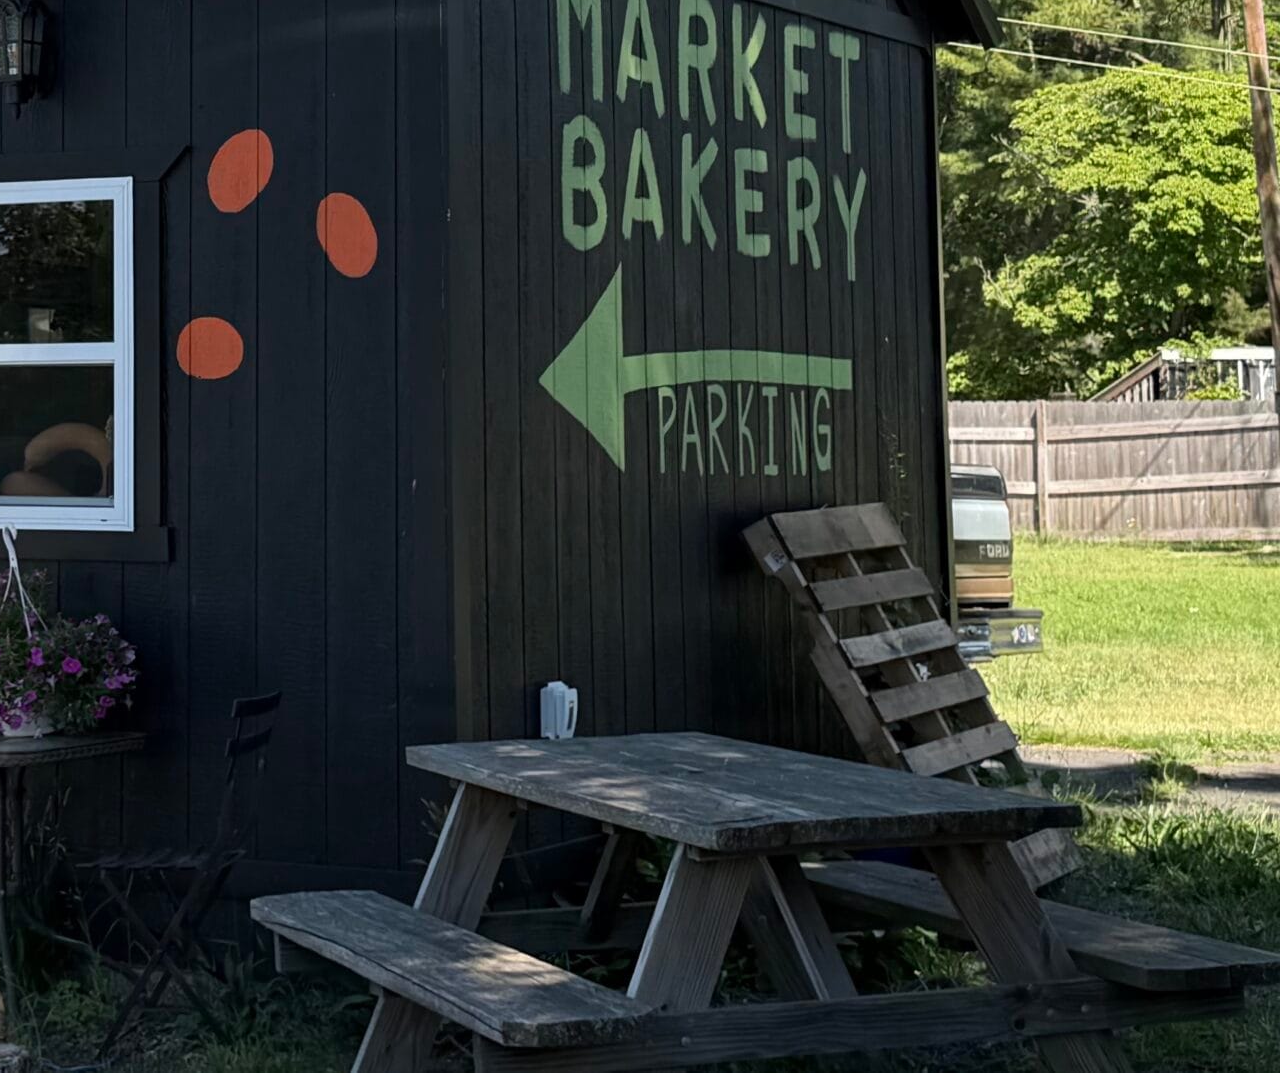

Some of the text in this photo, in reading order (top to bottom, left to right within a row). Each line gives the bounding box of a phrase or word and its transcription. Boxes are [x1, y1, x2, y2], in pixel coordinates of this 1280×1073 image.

[561, 114, 867, 282] BAKERY
[657, 383, 831, 477] PARKING
[978, 543, 1010, 559] FORD
